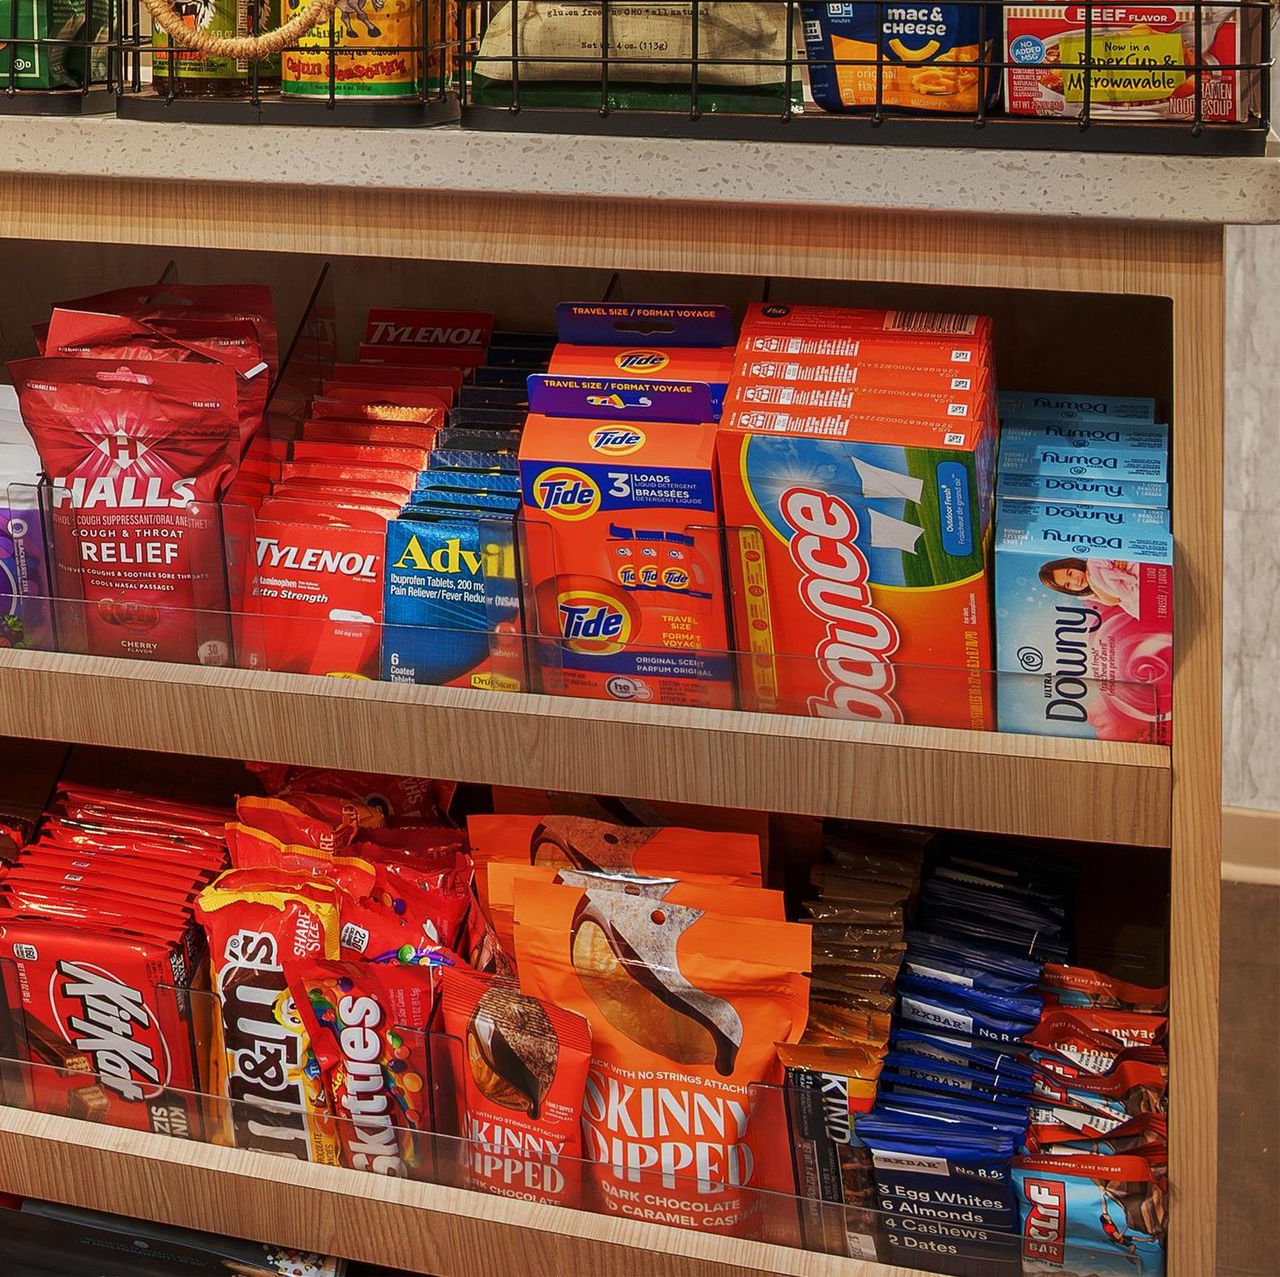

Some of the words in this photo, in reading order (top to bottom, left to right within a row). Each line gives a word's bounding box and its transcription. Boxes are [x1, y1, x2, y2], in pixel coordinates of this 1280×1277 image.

[887, 7, 928, 21] mac
[929, 7, 943, 22] &
[1077, 9, 1126, 22] BEEF
[1129, 14, 1168, 22] FLAVOR
[1016, 46, 1040, 56] ADDED
[1104, 42, 1126, 52] Now
[1130, 43, 1139, 51] in
[1021, 54, 1038, 62] MSG
[369, 322, 484, 344] TYLENOL
[622, 353, 665, 368] Tide
[594, 430, 641, 447] Tide
[1041, 451, 1117, 469] Downy
[608, 473, 629, 497] 3
[634, 474, 670, 483] LOADS
[53, 476, 197, 508] HALLS
[540, 480, 596, 509] Tide
[636, 487, 689, 498] BRASSÉES
[1046, 478, 1124, 497] Downy
[72, 529, 118, 537] COUGH
[133, 529, 183, 538] THROAT
[82, 543, 179, 563] RELIEF
[254, 538, 377, 577] TYLENOL
[391, 535, 515, 574] Advil
[91, 579, 113, 587] COOLS
[115, 581, 138, 590] NASAL
[140, 583, 174, 591] PASSAGES
[390, 575, 425, 585] Ibuprofen
[427, 577, 455, 590] Tablets,
[458, 579, 471, 589] 200
[664, 570, 688, 584] Tide
[277, 590, 327, 604] Strength
[560, 602, 622, 637] Tide
[662, 615, 698, 623] TRAVEL
[662, 632, 700, 640] FORMAT
[121, 641, 157, 649] CHERRY
[391, 653, 398, 664] 6
[1045, 606, 1102, 723] Downy
[390, 666, 414, 676] Coated
[1044, 673, 1052, 698] ULTRA
[611, 1068, 636, 1079] WITH
[638, 1070, 653, 1080] NO
[656, 1072, 700, 1083] STRINGS
[820, 1074, 850, 1144] KIND
[602, 1180, 639, 1202] DARK
[644, 1194, 740, 1212] CHOCOLATE
[879, 1183, 890, 1193] 3
[895, 1185, 930, 1202] Egg
[935, 1189, 1002, 1209] Whites
[882, 1200, 893, 1210] 6
[898, 1201, 983, 1222] Almonds
[1029, 1184, 1062, 1241] CLIF
[884, 1217, 897, 1228] 4
[902, 1217, 988, 1240] Cashews
[889, 1234, 899, 1244] 2
[902, 1234, 957, 1254] Dates
[1028, 1243, 1058, 1256] BAR
